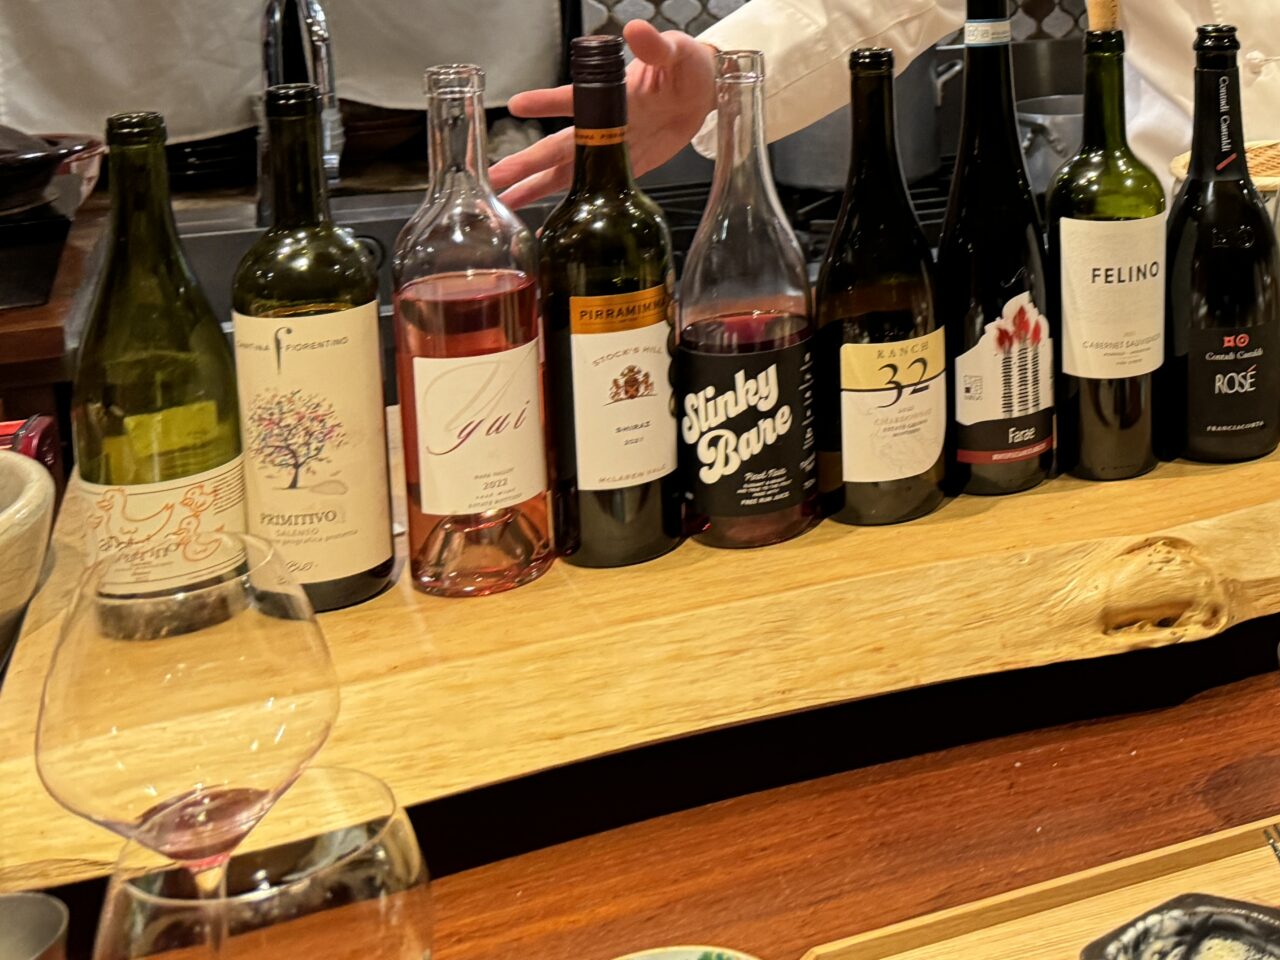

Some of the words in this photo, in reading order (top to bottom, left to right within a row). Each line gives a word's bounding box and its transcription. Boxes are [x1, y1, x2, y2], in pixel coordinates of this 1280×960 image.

[1090, 261, 1160, 284] FELINO
[875, 357, 930, 409] 32
[1214, 363, 1257, 395] ROSÉ
[681, 362, 779, 445] Slinky
[615, 420, 652, 434] SHIRAZ
[1007, 426, 1037, 445] Farae
[696, 404, 793, 485] Bare
[259, 509, 337, 527] PRIMITIVO
